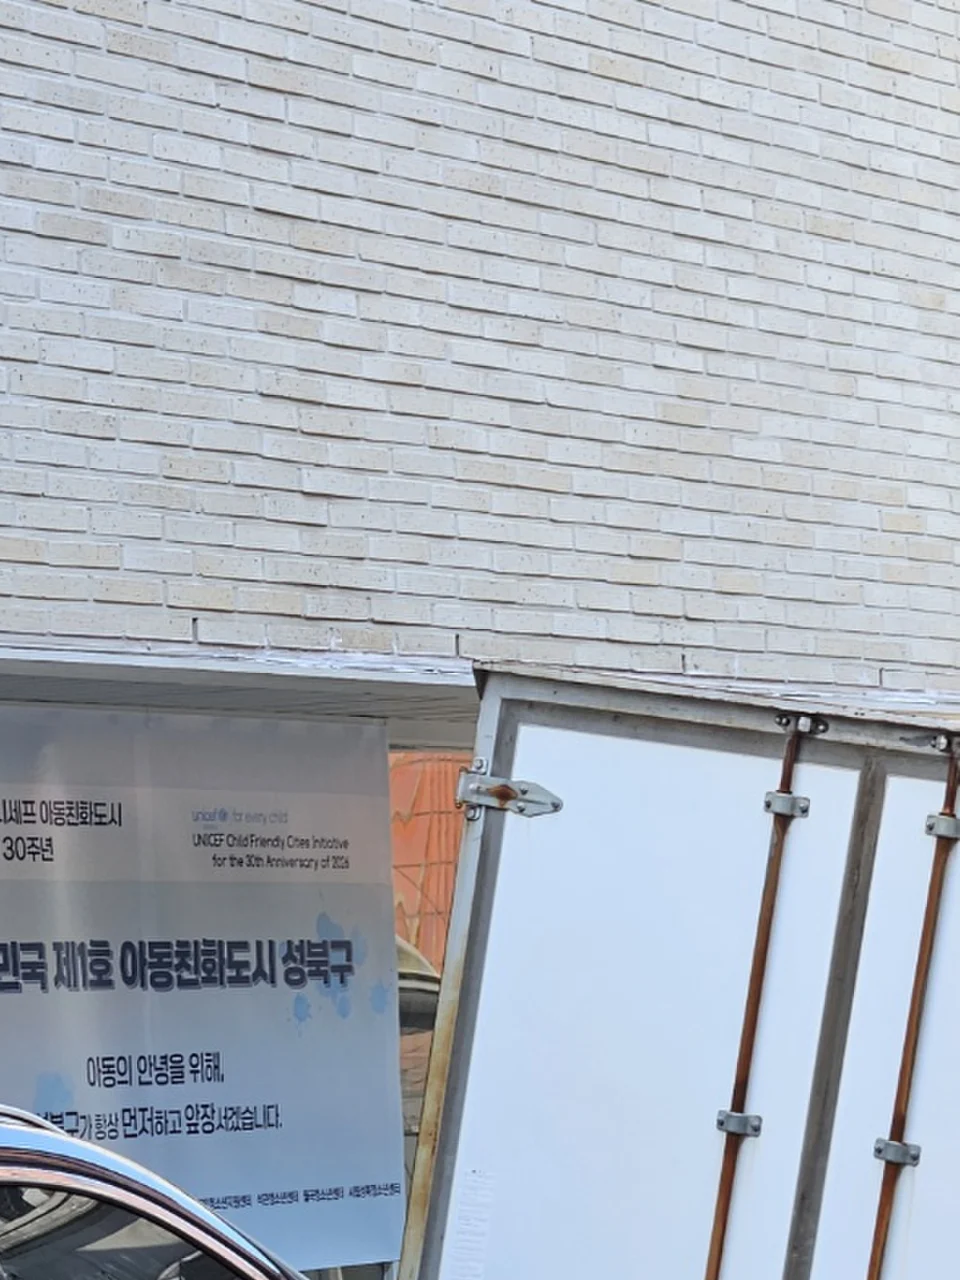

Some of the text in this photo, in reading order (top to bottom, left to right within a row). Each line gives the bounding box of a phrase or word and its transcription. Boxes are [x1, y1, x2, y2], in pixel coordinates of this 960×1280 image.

[40, 801, 122, 827] 아동친화도시
[2, 836, 54, 862] 30주년
[193, 834, 224, 848] UNICEF
[226, 834, 249, 848] Child
[250, 834, 285, 850] Friendly
[212, 854, 227, 868] for
[229, 854, 244, 868] the
[265, 855, 318, 872] Anniversary
[52, 940, 115, 991] 제1호
[120, 939, 277, 992] 아동친화도시
[281, 939, 355, 989] 성북구
[87, 1056, 133, 1088] 아동의
[137, 1053, 185, 1086] 안녕을
[95, 1112, 119, 1140] 항상
[122, 1106, 182, 1139] 먼저하고
